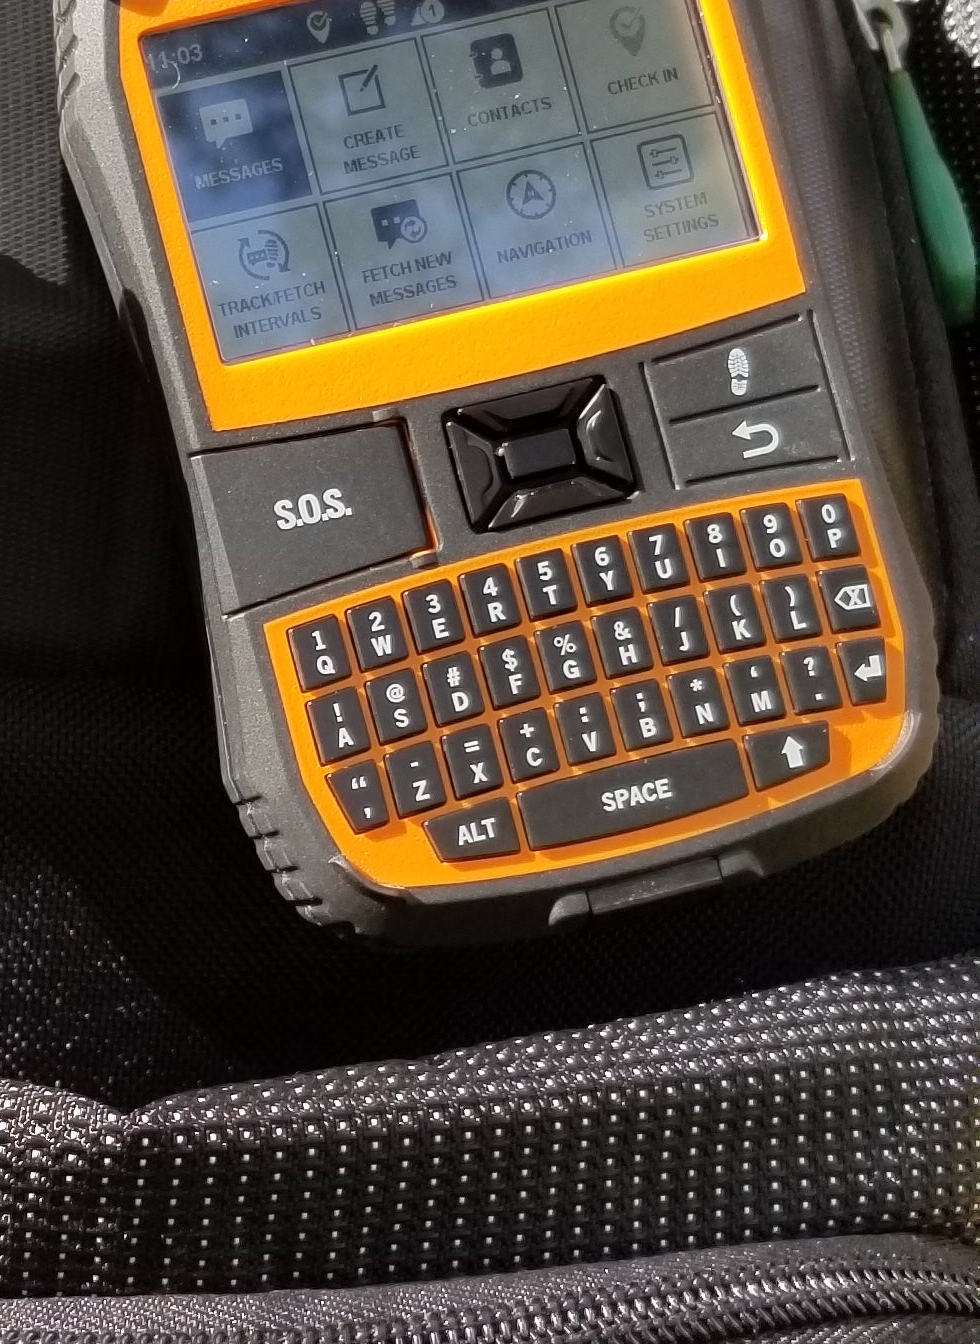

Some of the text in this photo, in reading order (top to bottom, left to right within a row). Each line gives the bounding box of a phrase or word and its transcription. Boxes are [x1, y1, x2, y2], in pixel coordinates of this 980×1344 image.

[147, 43, 203, 72] 11:03
[607, 67, 680, 96] CHECK IN
[466, 95, 553, 128] CONTACTS
[343, 123, 405, 150] CREATE
[194, 157, 284, 190] MESSAGES
[343, 145, 421, 174] MESSAGE
[643, 191, 708, 219] SYSTEM
[643, 214, 720, 243] SETTINGS
[496, 229, 593, 265] NAVIGATION
[361, 250, 453, 284] FETCH NEW
[219, 280, 326, 318] TRACK/FETCH
[369, 274, 458, 307] MESSAGES
[233, 305, 323, 339] INTERVALS
[273, 487, 353, 530] S.O.S.
[311, 503, 840, 651] 1 2 3 4 5 6 7 8 9 0
[316, 527, 845, 675] Q W E R T Y U I O P
[338, 610, 808, 749] A S D F G H J K L
[412, 779, 431, 802] Z
[469, 761, 489, 784] X
[526, 747, 544, 767] C
[581, 730, 598, 752] V
[638, 717, 658, 739] B
[694, 702, 716, 725] N
[750, 689, 774, 713] M
[458, 777, 674, 846] ALT SPACE
